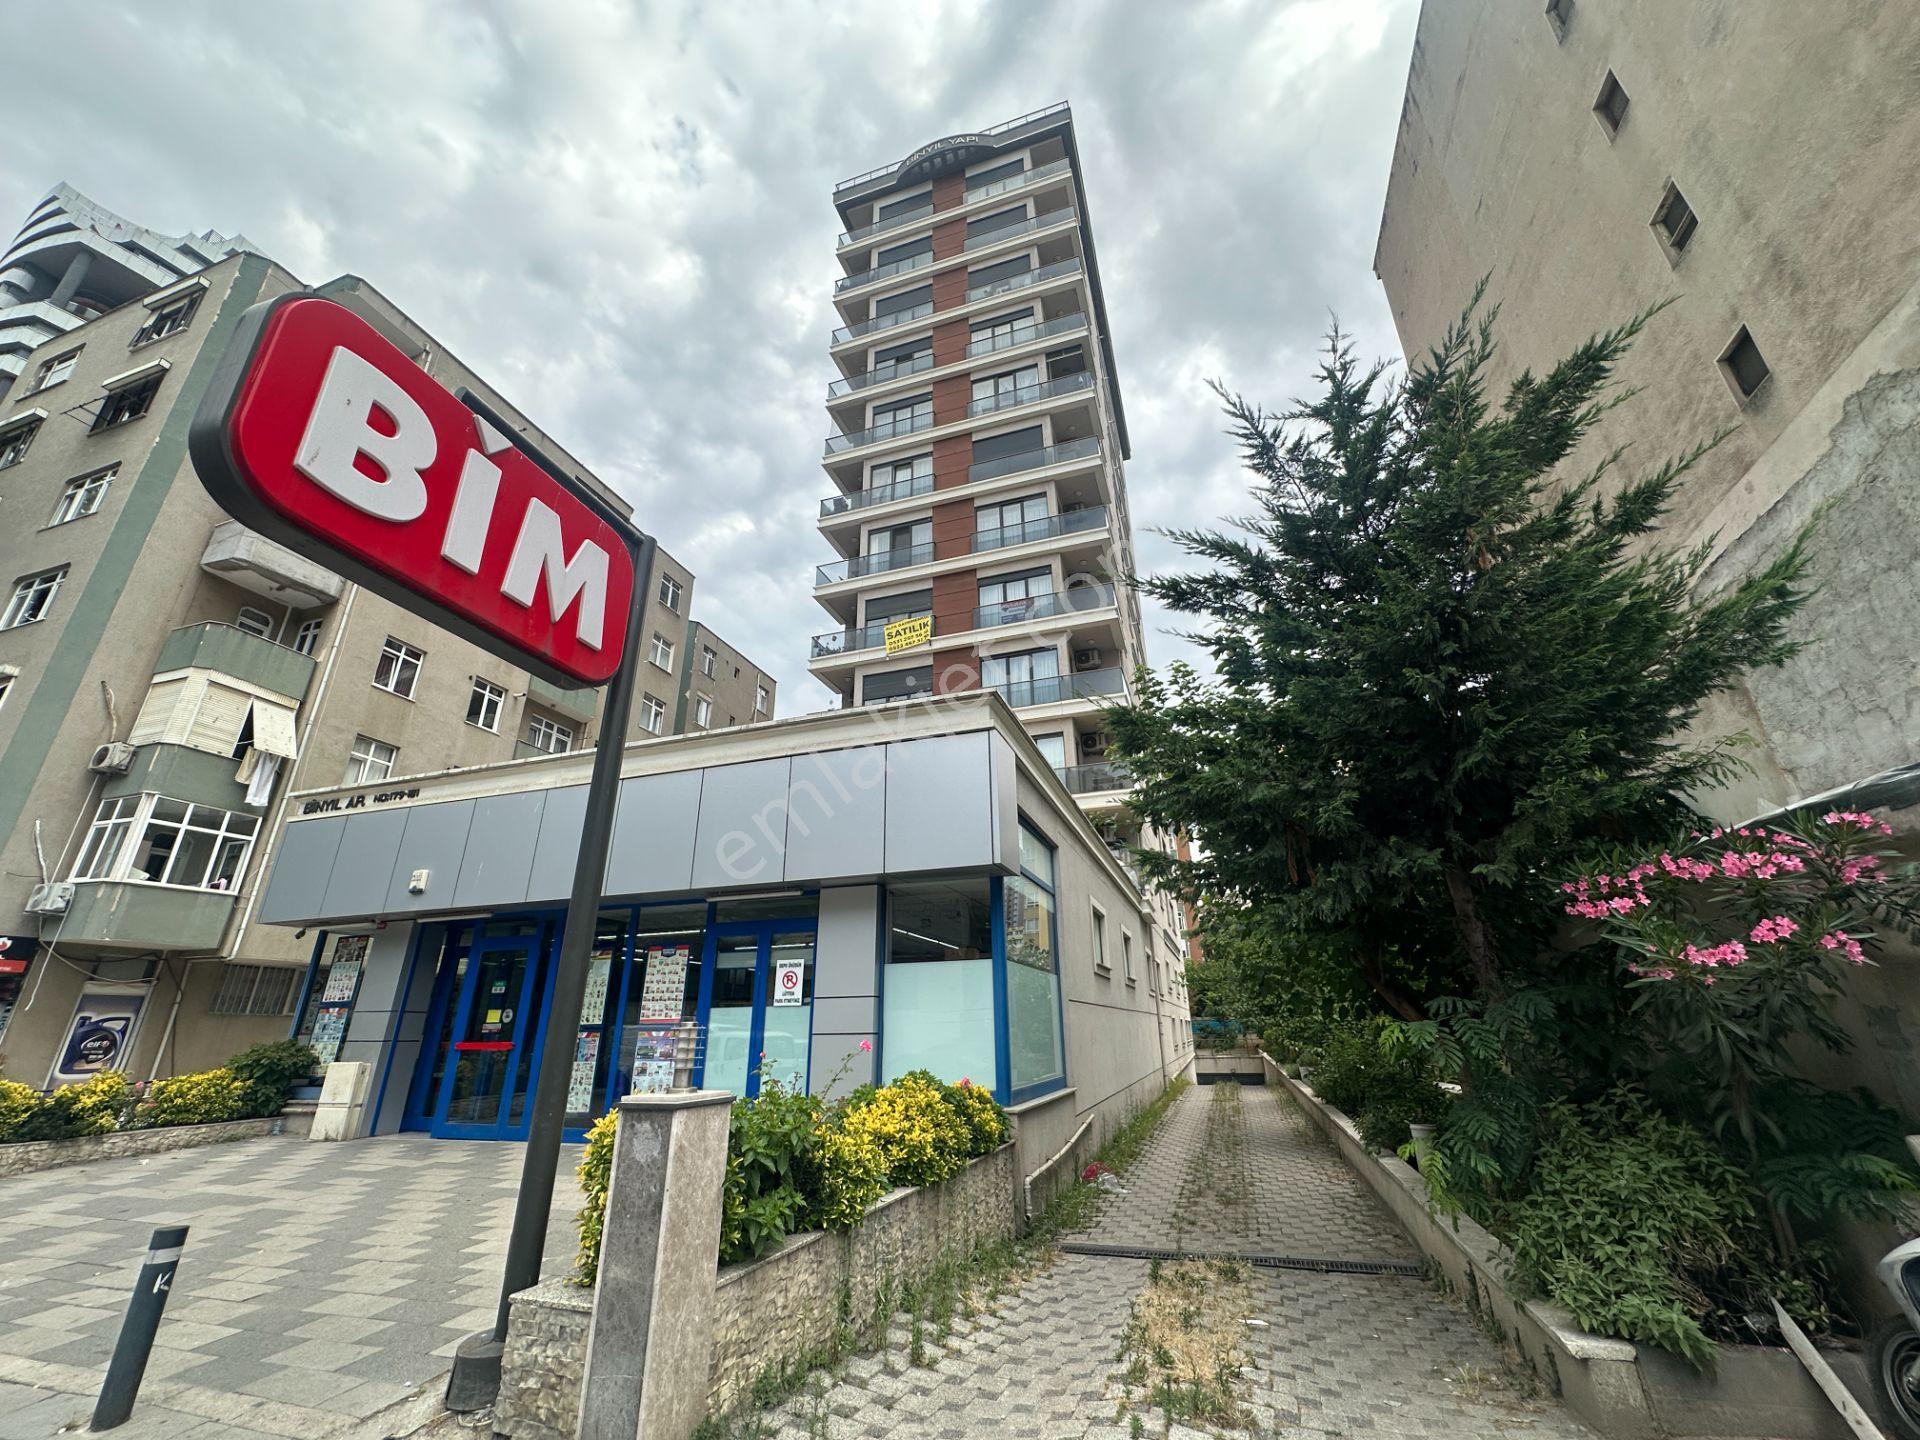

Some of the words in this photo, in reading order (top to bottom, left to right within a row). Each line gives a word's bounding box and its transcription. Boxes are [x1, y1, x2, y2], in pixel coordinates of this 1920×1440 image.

[948, 135, 979, 145] YAPI
[293, 345, 610, 651] BİM
[886, 621, 930, 640] SATILIK
